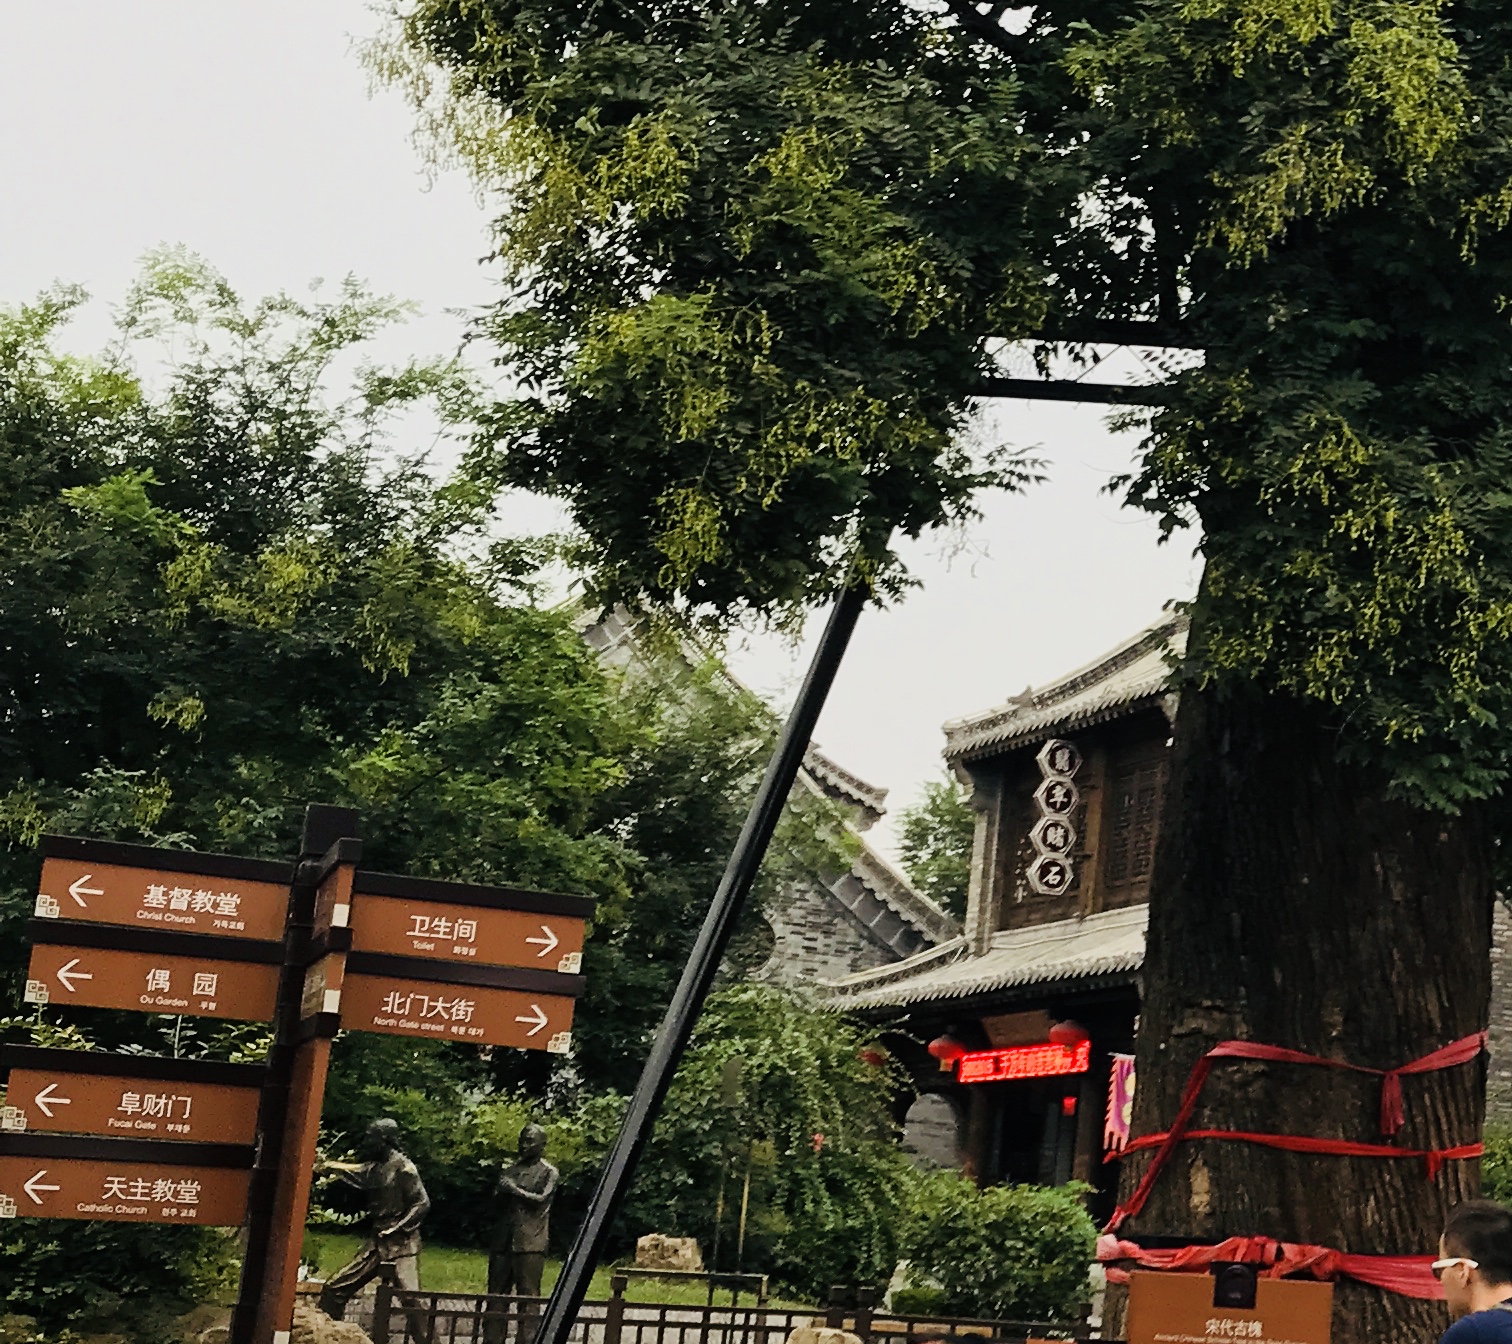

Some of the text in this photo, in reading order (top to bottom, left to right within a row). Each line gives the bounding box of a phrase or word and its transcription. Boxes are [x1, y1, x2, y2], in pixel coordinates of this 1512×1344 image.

[143, 883, 241, 917] 基督教堂
[136, 909, 196, 925] Christ Church
[406, 915, 478, 943] 卫生间
[412, 940, 435, 952] Toilet
[140, 994, 188, 1007] Ou Garden
[381, 991, 475, 1023] 北门大街
[373, 1016, 397, 1027] North
[398, 1018, 419, 1030] Gate
[117, 1091, 192, 1119] 阜财门
[108, 1118, 157, 1131] Fucai Gate
[102, 1176, 201, 1204] 天主教堂
[76, 1202, 148, 1216] Catholic Church
[1205, 1318, 1263, 1338] 宋代古槐
